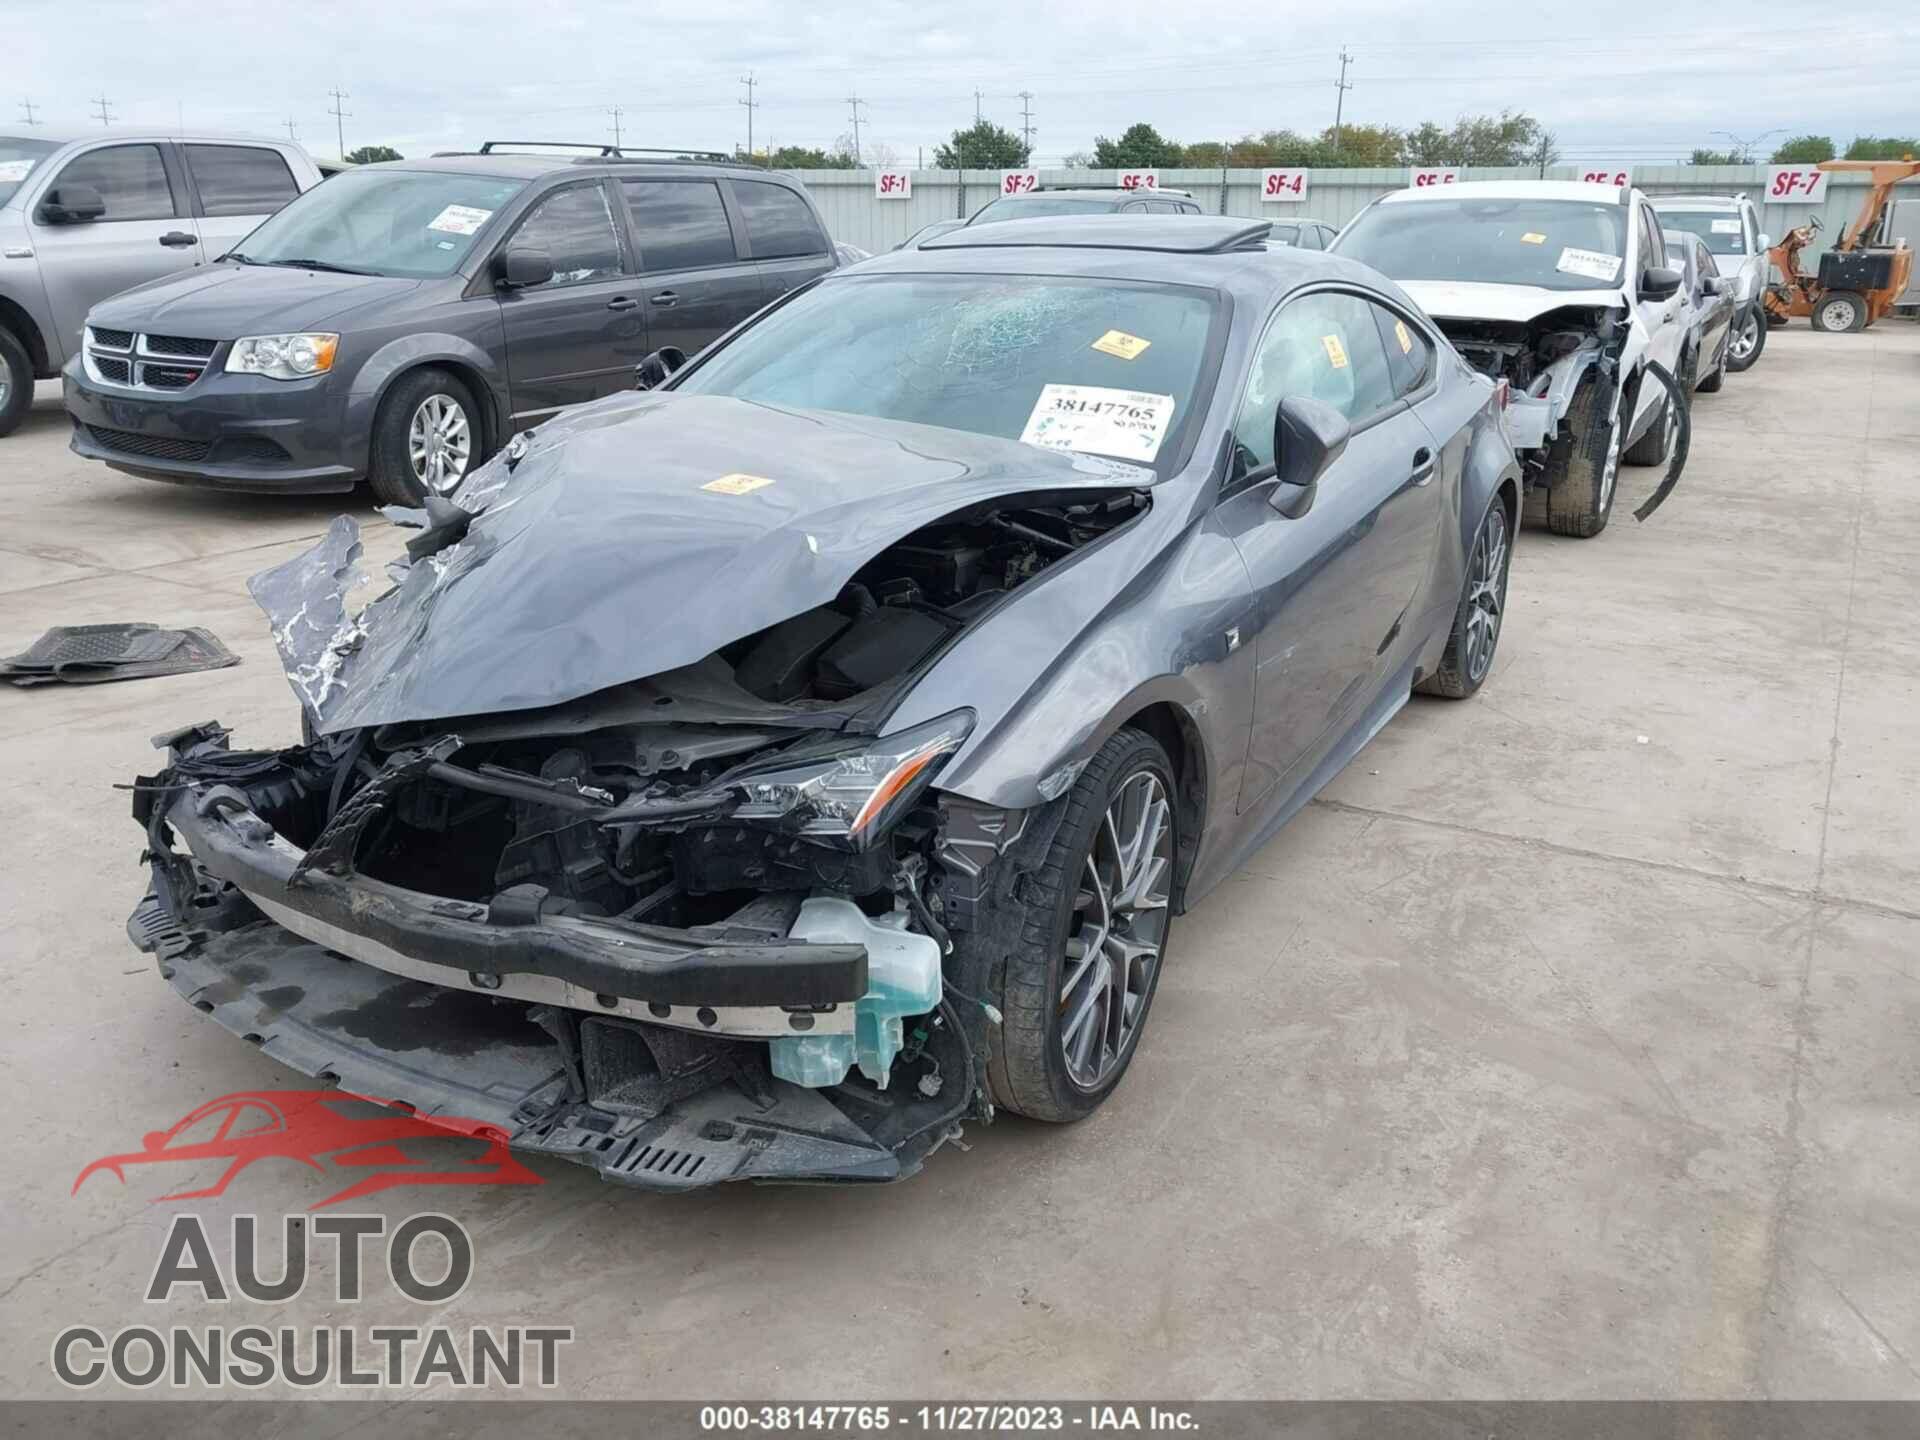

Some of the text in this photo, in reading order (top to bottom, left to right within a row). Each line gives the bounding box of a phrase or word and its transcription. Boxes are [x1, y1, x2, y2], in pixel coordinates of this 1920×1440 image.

[880, 175, 906, 193] SF-1
[1005, 175, 1035, 193] SF-2
[1266, 175, 1302, 194] SF-4
[1416, 174, 1454, 187] SF
[1772, 172, 1820, 196] SF-7
[1049, 398, 1156, 420] 38147765
